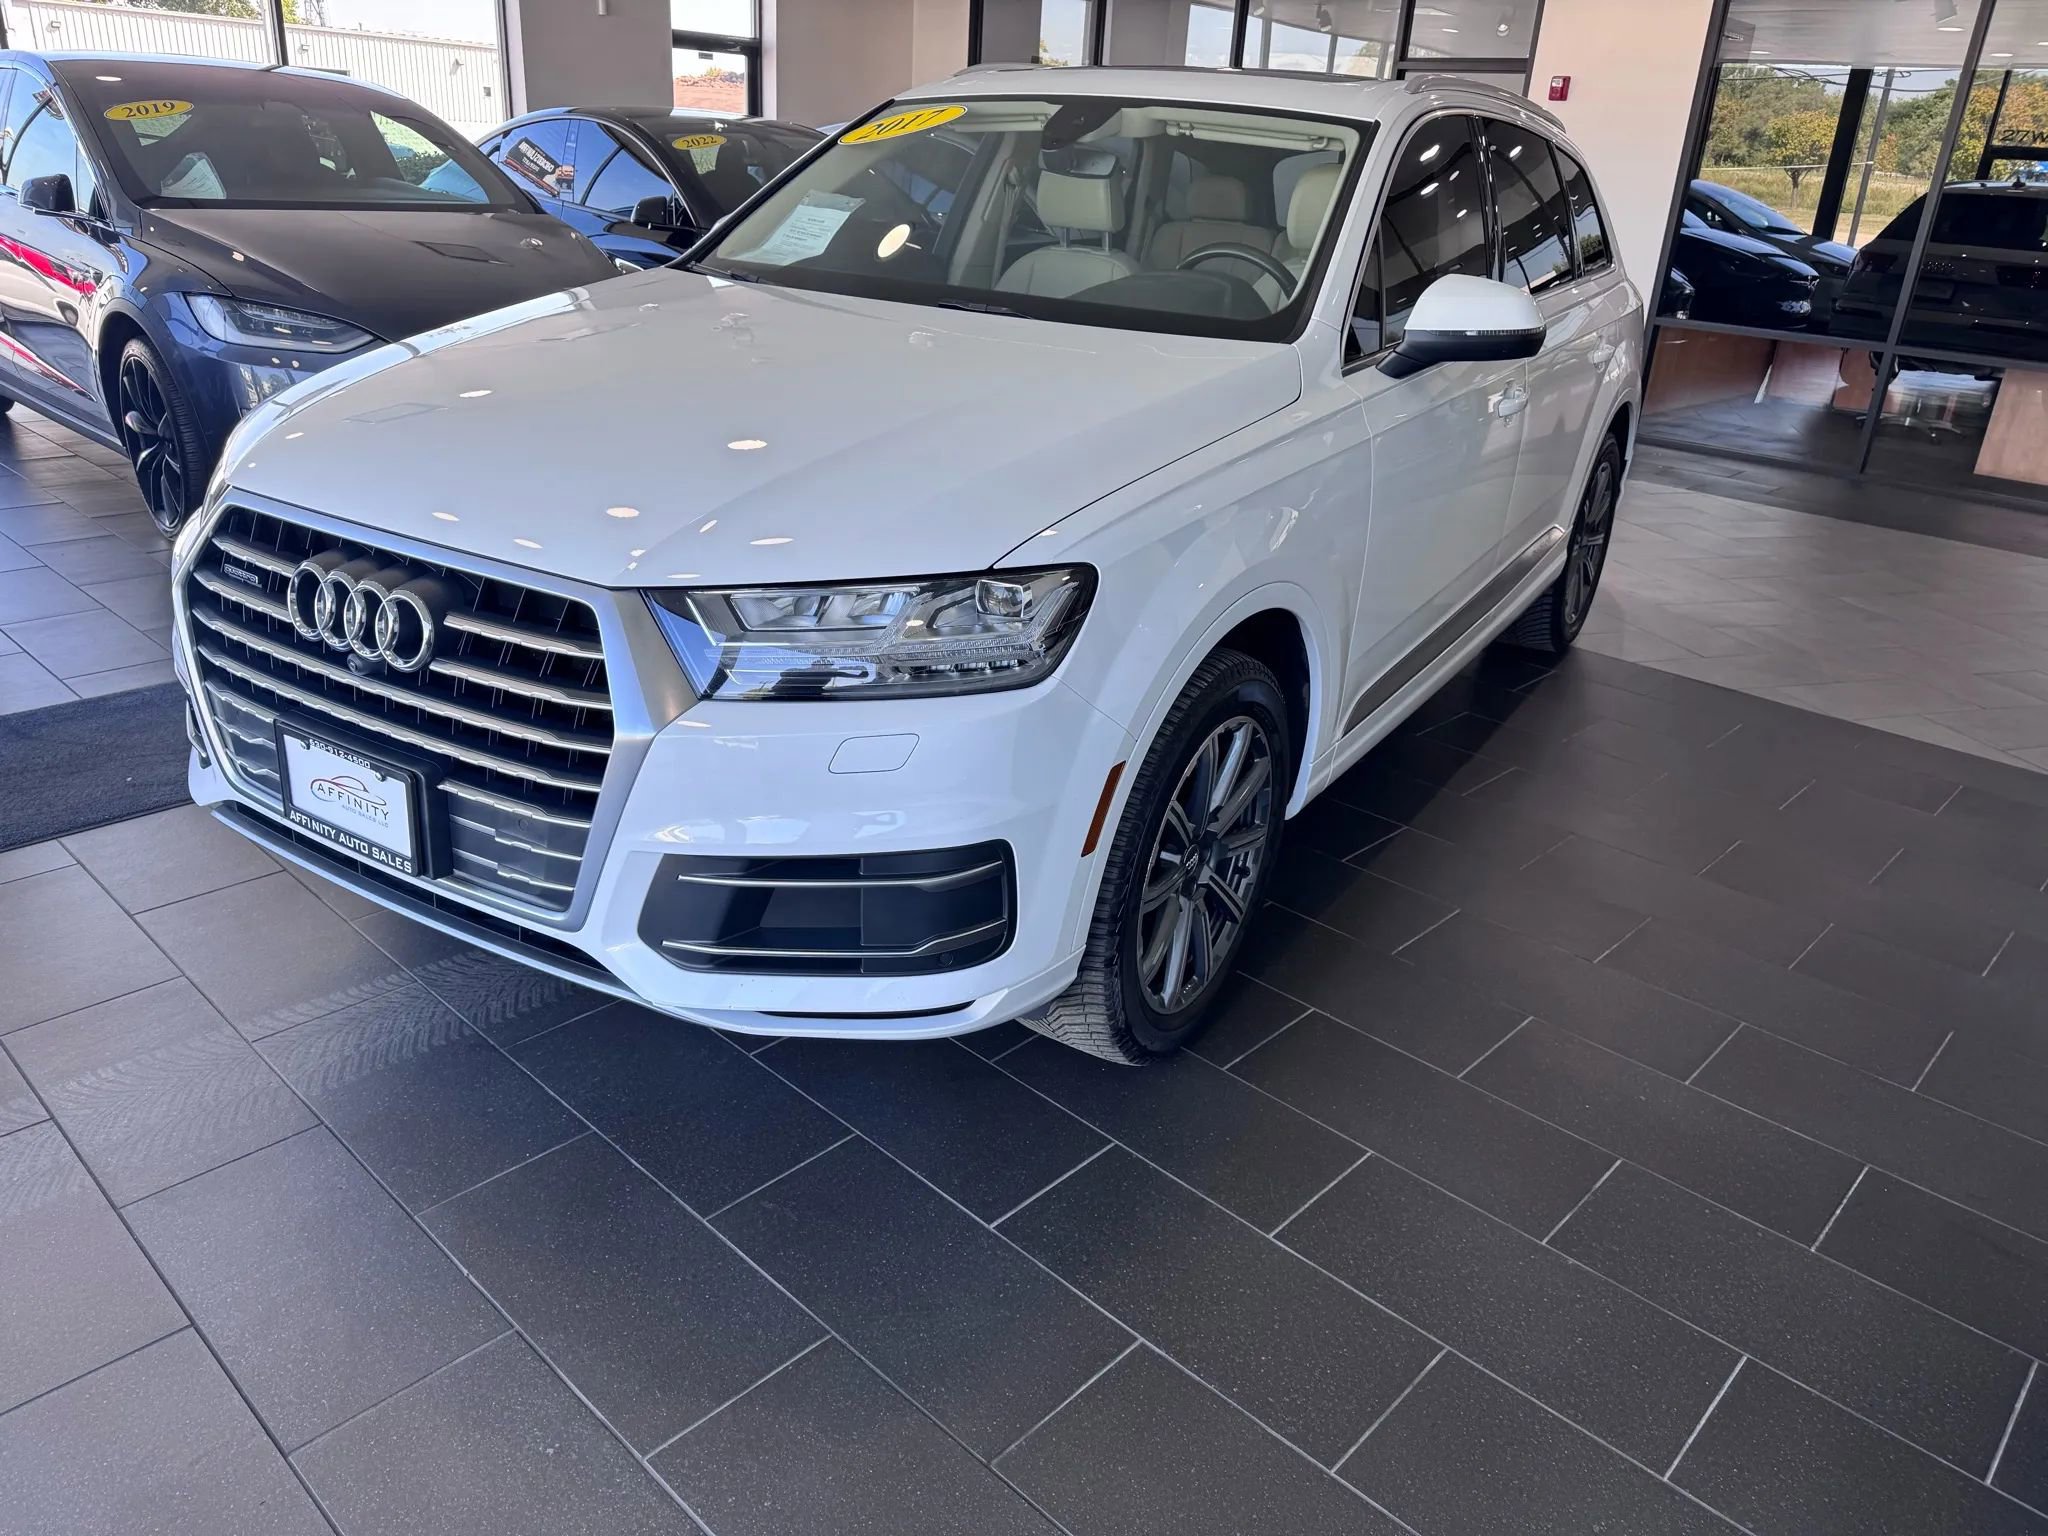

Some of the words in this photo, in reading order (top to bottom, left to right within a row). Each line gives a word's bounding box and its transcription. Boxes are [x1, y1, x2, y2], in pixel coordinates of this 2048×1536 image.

[121, 101, 176, 118] 2019
[854, 108, 949, 141] 2017
[682, 135, 718, 148] 2022
[309, 738, 371, 769] 630-912-4500
[317, 783, 389, 821] AFFINITY
[289, 810, 336, 839] AFFINITY
[339, 833, 369, 854] AUTO
[372, 847, 412, 874] SALES
